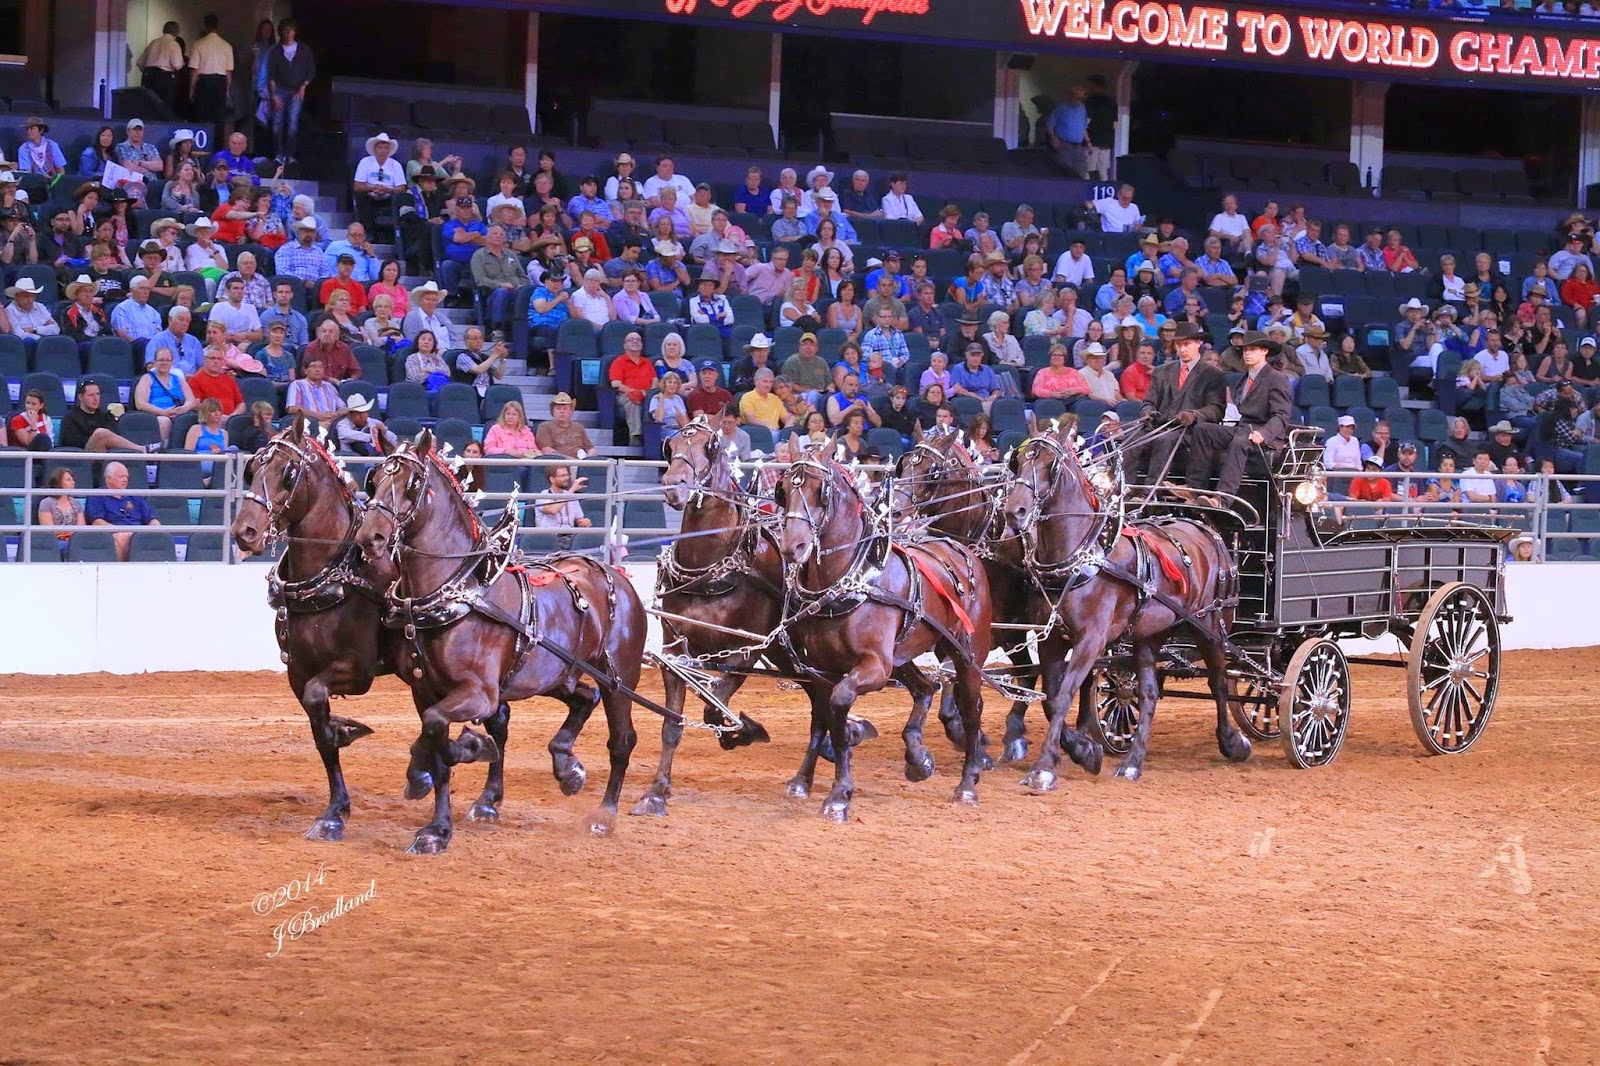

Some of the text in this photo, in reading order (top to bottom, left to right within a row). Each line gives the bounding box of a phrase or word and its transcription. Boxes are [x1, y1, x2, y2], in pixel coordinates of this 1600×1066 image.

[1020, 0, 1228, 51] WELCOME
[1236, 11, 1291, 56] TO
[1299, 16, 1439, 68] WORLD
[1092, 185, 1116, 201] 119
